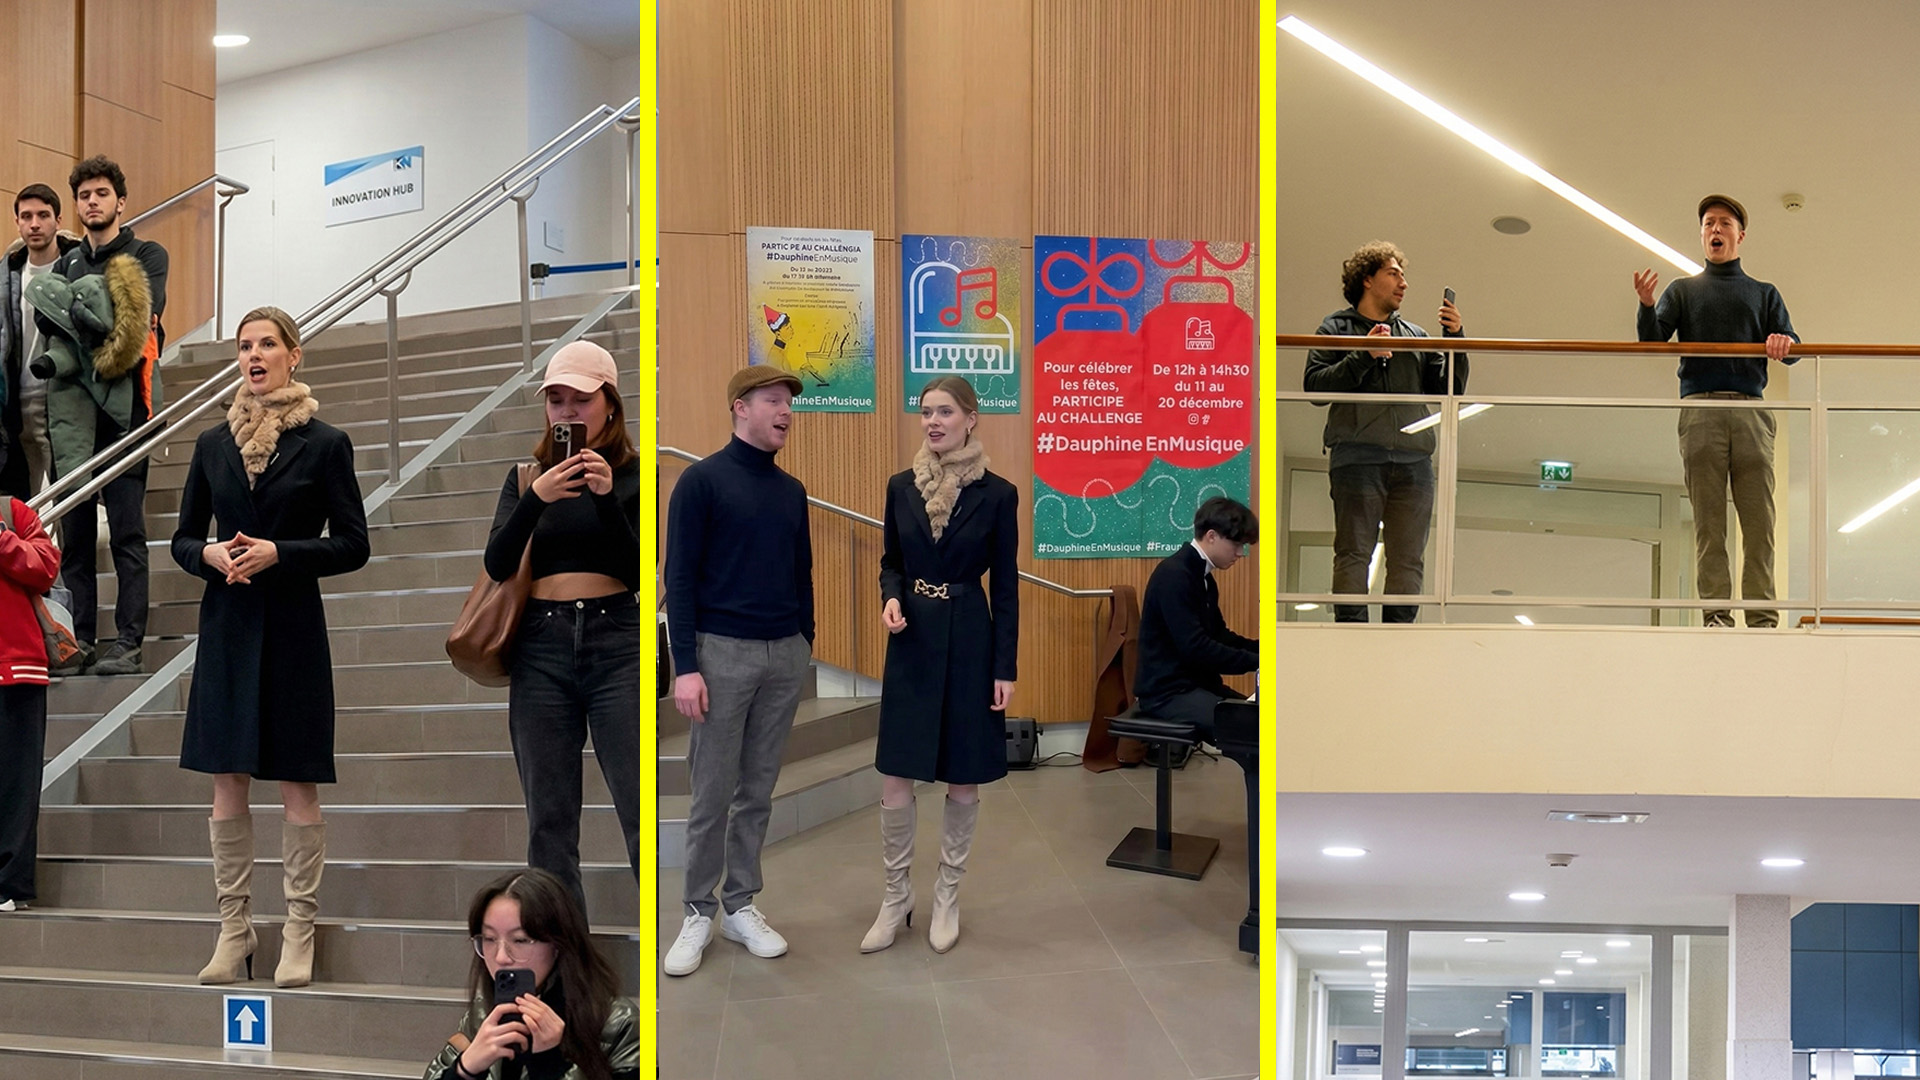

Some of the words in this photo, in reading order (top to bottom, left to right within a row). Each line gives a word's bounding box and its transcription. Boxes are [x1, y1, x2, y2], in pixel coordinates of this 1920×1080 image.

[331, 188, 391, 207] INNOVATION
[393, 183, 414, 196] HUB
[766, 252, 858, 264] #DauphineEnMusique
[1043, 361, 1075, 374] Pour
[1078, 361, 1133, 374] célébrer
[1153, 364, 1171, 376] De
[1174, 364, 1196, 376] 12h
[1199, 363, 1207, 376] à
[1210, 364, 1250, 376] 14h30
[1060, 379, 1079, 391] les
[1083, 378, 1119, 393] fêtes,
[1174, 380, 1191, 392] du
[1195, 381, 1205, 392] 11
[1209, 383, 1225, 392] au
[1052, 396, 1124, 407] PARTICIPE
[1158, 397, 1176, 408] 20
[1179, 396, 1244, 408] décembre
[1036, 412, 1057, 424] AU
[1060, 412, 1143, 424] CHALLENGE
[1037, 432, 1143, 455] #Dauphine
[1146, 436, 1244, 454] EnMusique
[1038, 542, 1141, 553] #DauphineEnMusique
